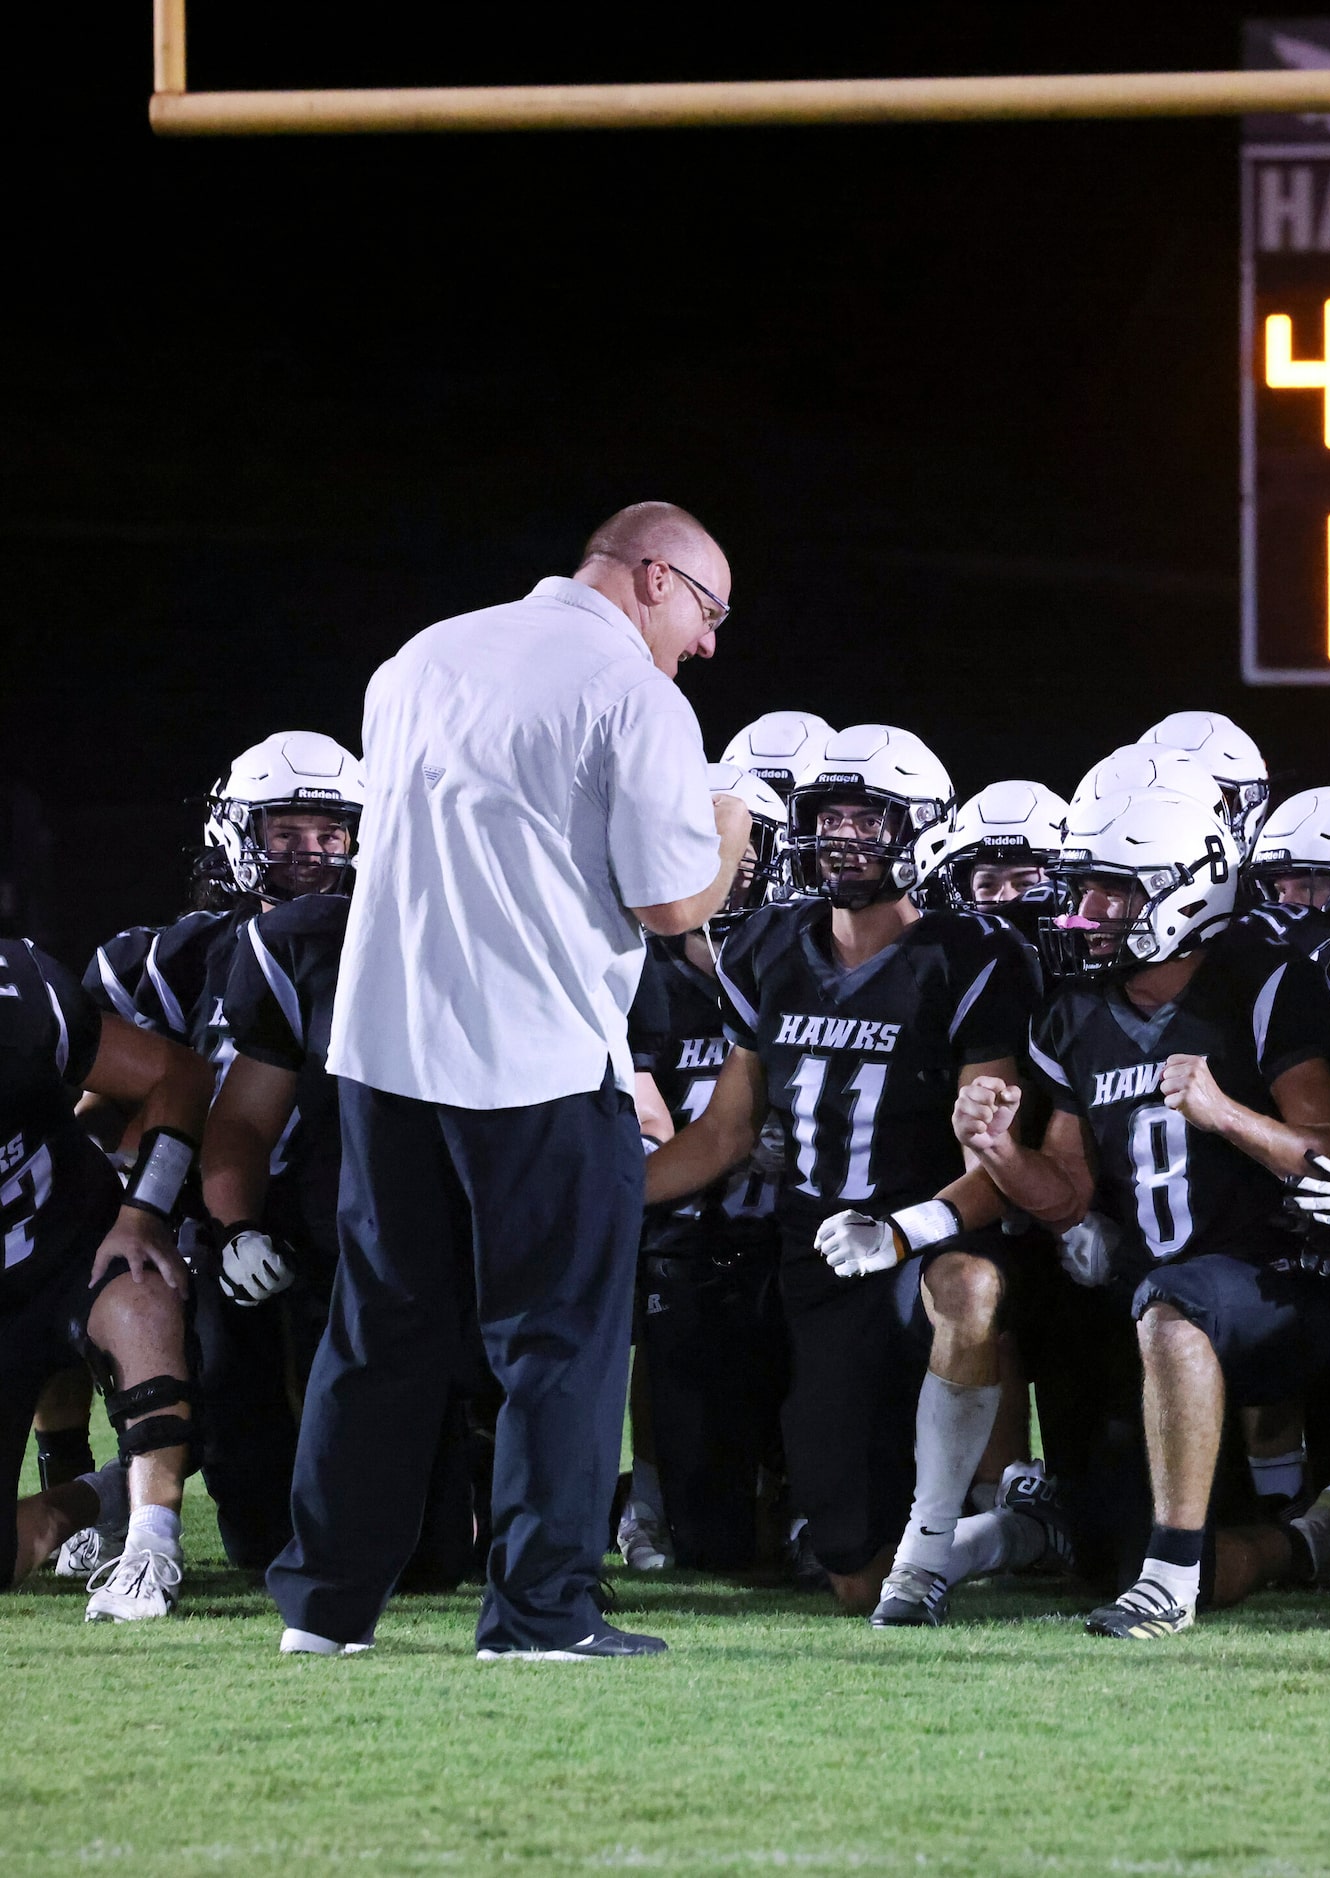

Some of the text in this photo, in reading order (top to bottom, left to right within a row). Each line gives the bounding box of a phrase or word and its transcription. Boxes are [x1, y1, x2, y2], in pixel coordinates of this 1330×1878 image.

[983, 836, 1024, 847] Riddell
[1205, 835, 1228, 884] 8
[774, 1014, 902, 1053] HAWKS
[785, 1057, 890, 1200] 11
[1130, 1104, 1194, 1258] 8
